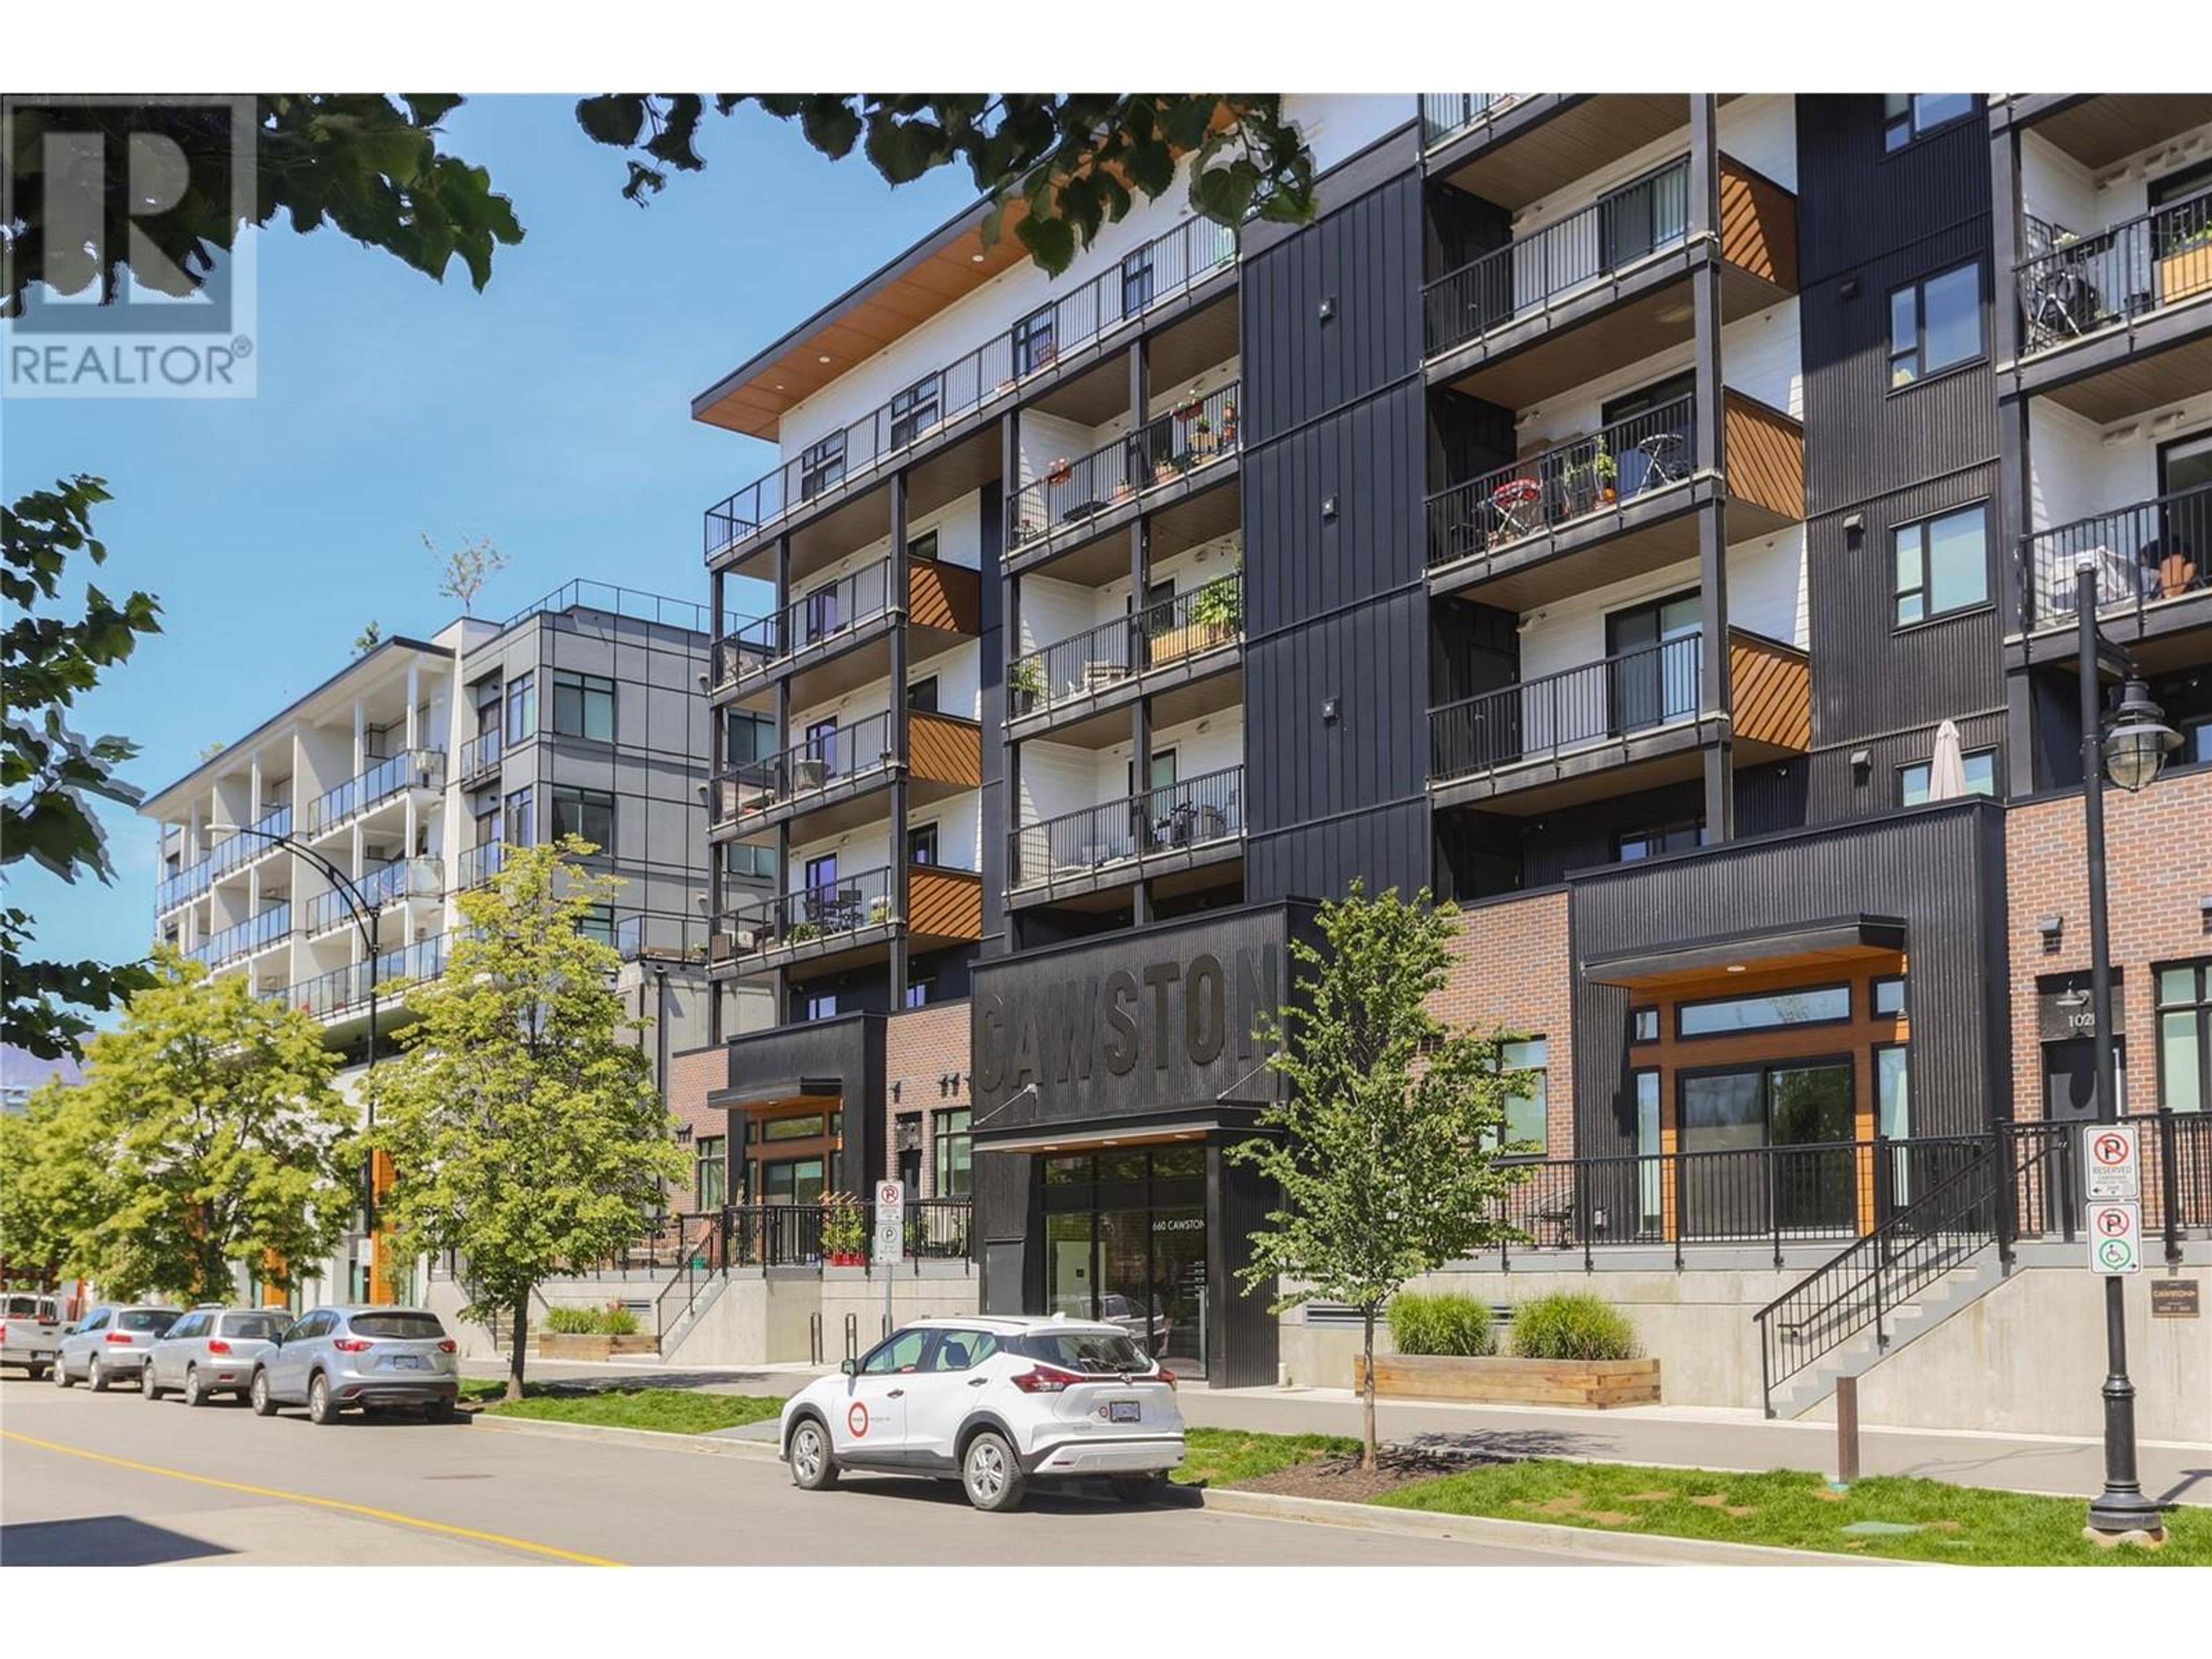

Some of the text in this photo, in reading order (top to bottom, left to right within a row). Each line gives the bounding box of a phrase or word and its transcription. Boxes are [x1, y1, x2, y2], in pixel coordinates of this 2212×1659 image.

[979, 942, 1278, 1092] CAWSTON
[1152, 1218, 1205, 1231] 660 CAWSTON
